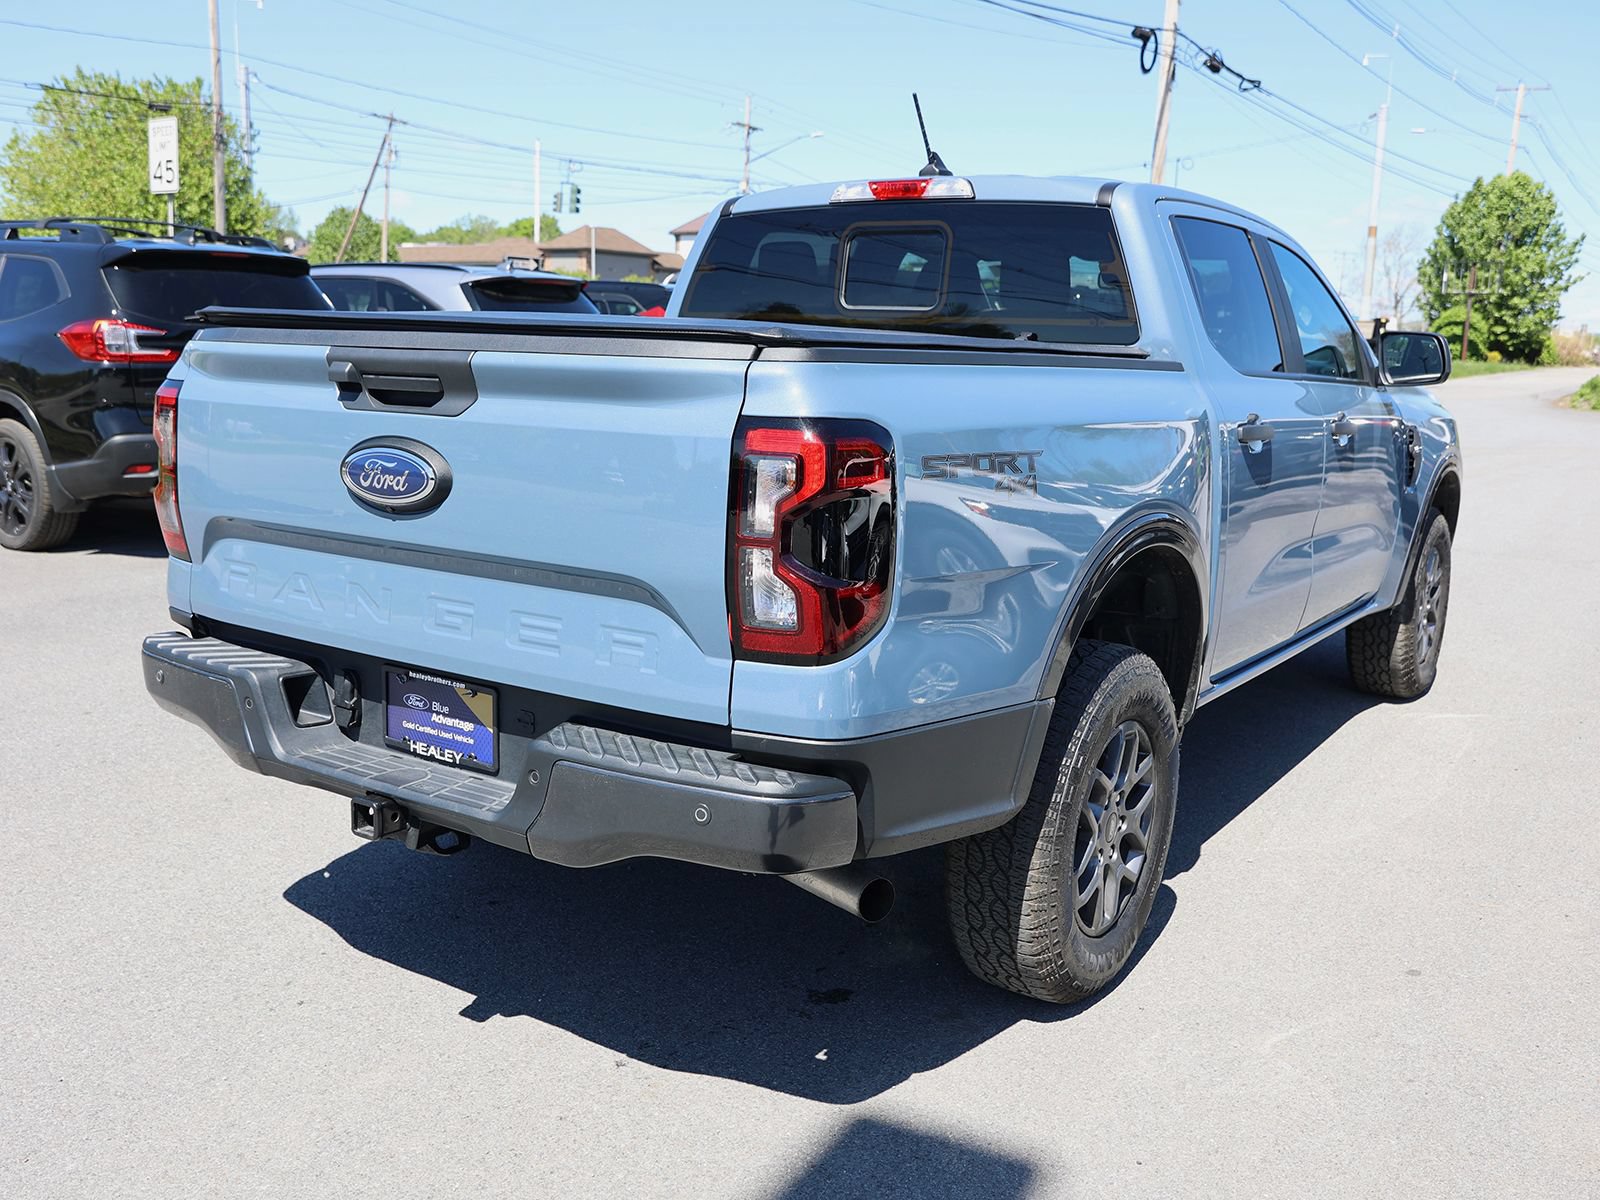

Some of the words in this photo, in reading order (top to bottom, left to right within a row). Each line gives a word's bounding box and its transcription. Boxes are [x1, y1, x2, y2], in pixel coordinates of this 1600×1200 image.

[153, 159, 175, 184] 45
[360, 458, 410, 492] Ford
[921, 450, 1044, 480] SPORT
[219, 558, 660, 675] RANGER
[408, 670, 466, 689] healeybrothers.com
[407, 694, 426, 709] Ford
[431, 701, 450, 714] Blue
[402, 720, 415, 730] Gold
[415, 724, 438, 736] Certified
[438, 730, 453, 740] Used
[453, 733, 475, 745] Vehicle
[430, 713, 475, 732] Advantage
[409, 740, 464, 764] HEALEY
